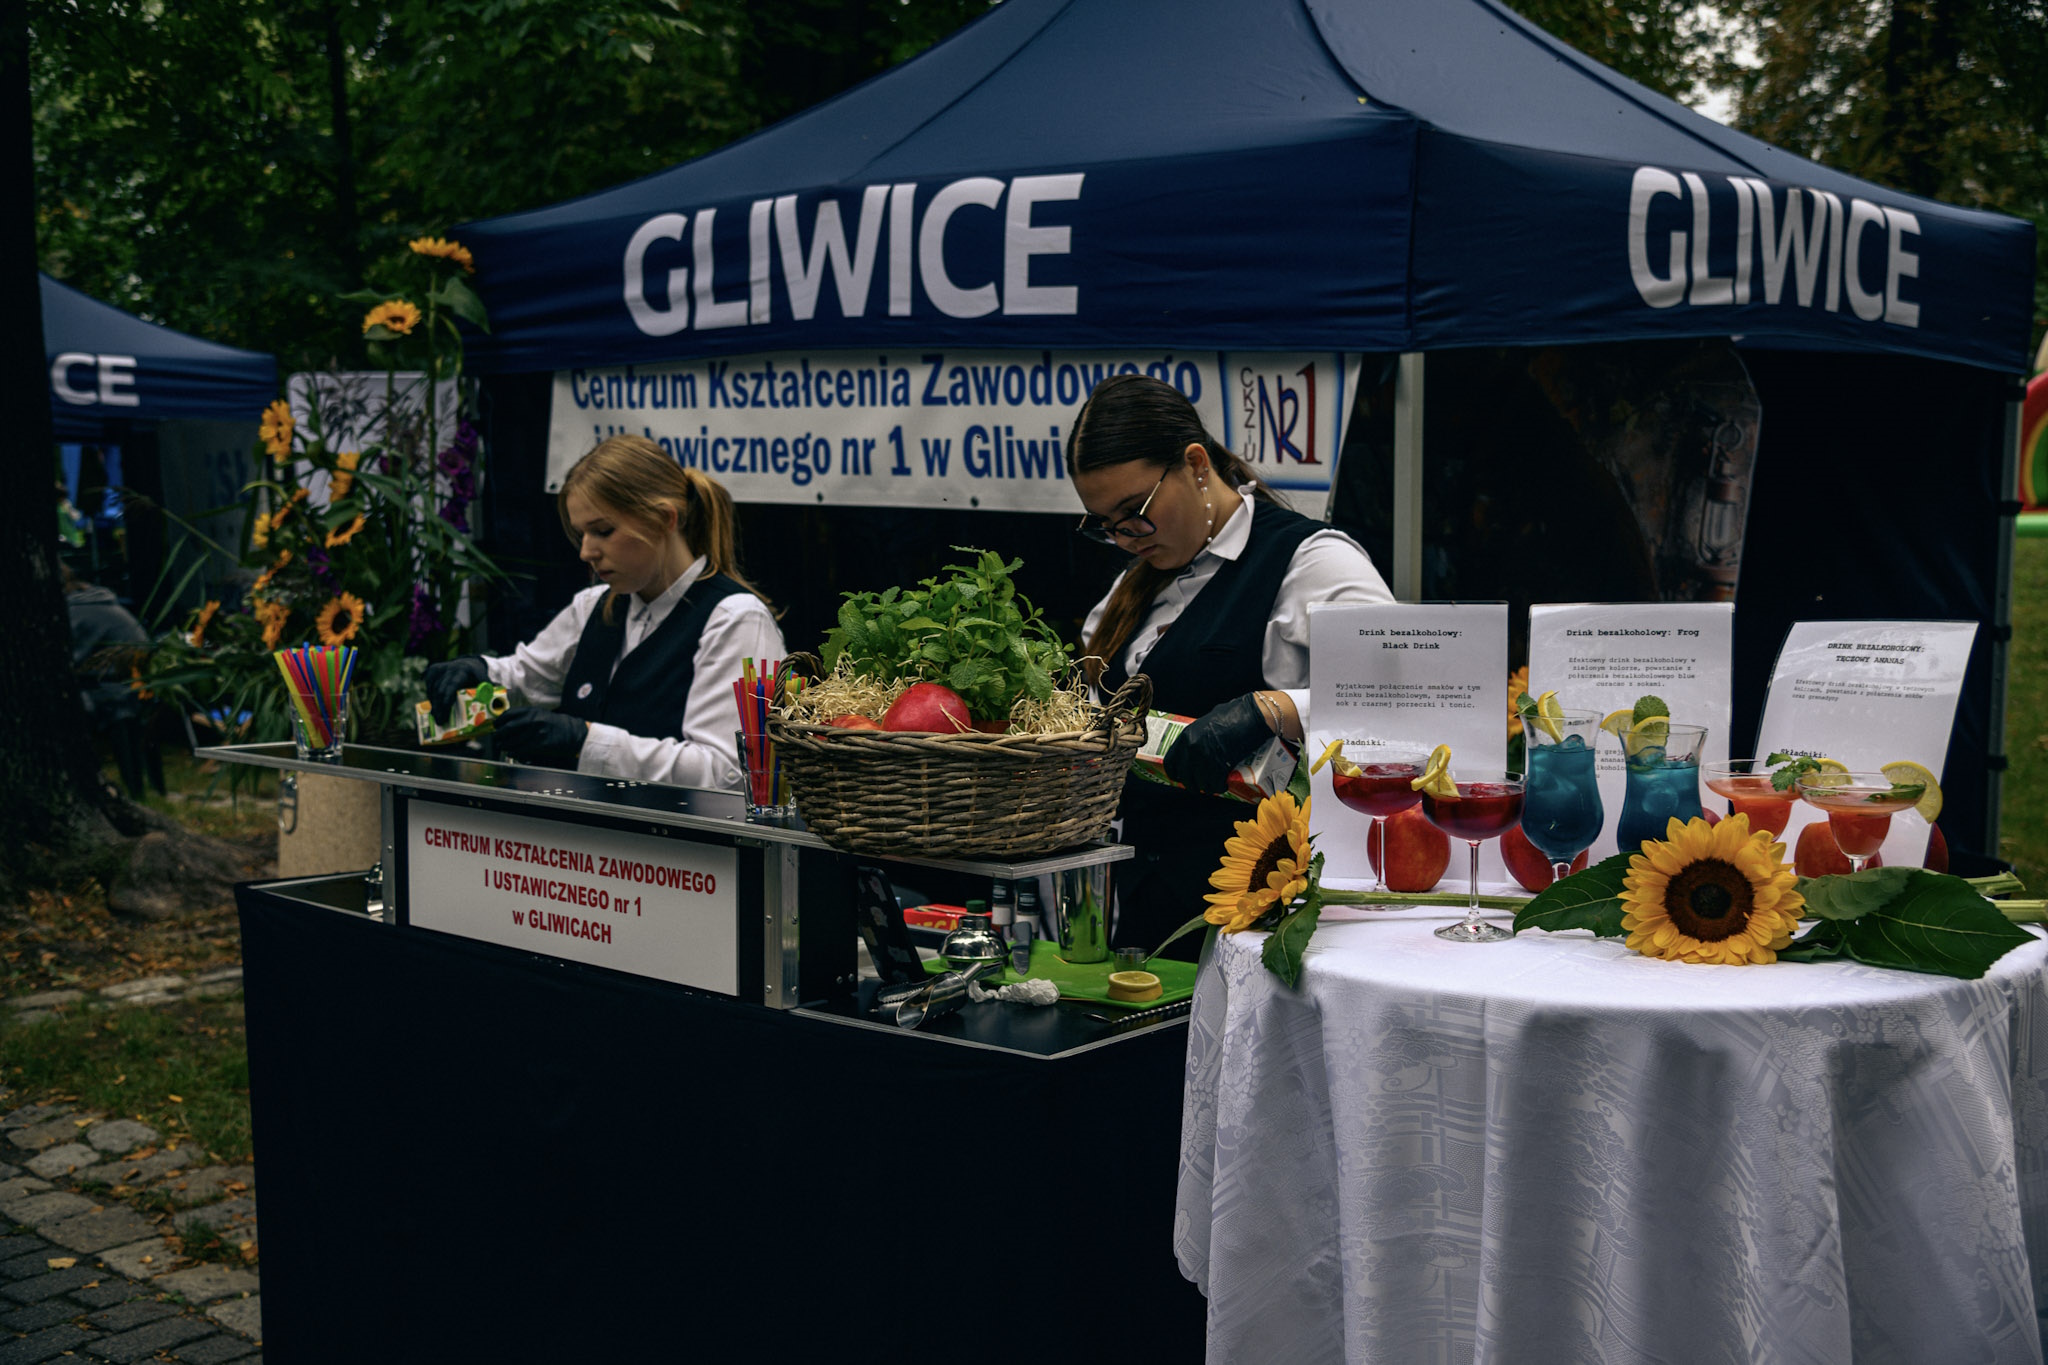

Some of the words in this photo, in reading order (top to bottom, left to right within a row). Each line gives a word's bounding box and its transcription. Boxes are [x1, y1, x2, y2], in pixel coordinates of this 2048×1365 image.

[623, 173, 1085, 337] GLIWICE
[1628, 166, 1921, 328] GLIWICE
[571, 365, 697, 409] Centrum
[708, 355, 910, 408] Kształcenia
[921, 351, 1202, 407] Zawodowo
[608, 425, 831, 487] wicznego
[841, 436, 876, 476] nr
[888, 425, 911, 476] 1
[921, 438, 951, 477] w
[963, 425, 1065, 479] Gliwi
[1390, 629, 1463, 638] bezalkoholowy:
[1598, 629, 1671, 637] bezalkoholowy:
[1677, 629, 1699, 637] Frog
[1397, 701, 1436, 709] porzeczki
[424, 827, 491, 856] CENTRUM
[495, 838, 594, 874] KSZTAŁCENIA
[599, 856, 716, 895] ZAWODOWEGO
[484, 868, 489, 887] I
[494, 871, 609, 911] USTAWICZNEGO
[614, 896, 630, 914] nr
[634, 896, 642, 917] 1
[512, 910, 524, 926] w
[529, 909, 612, 944] GLIWICACH
